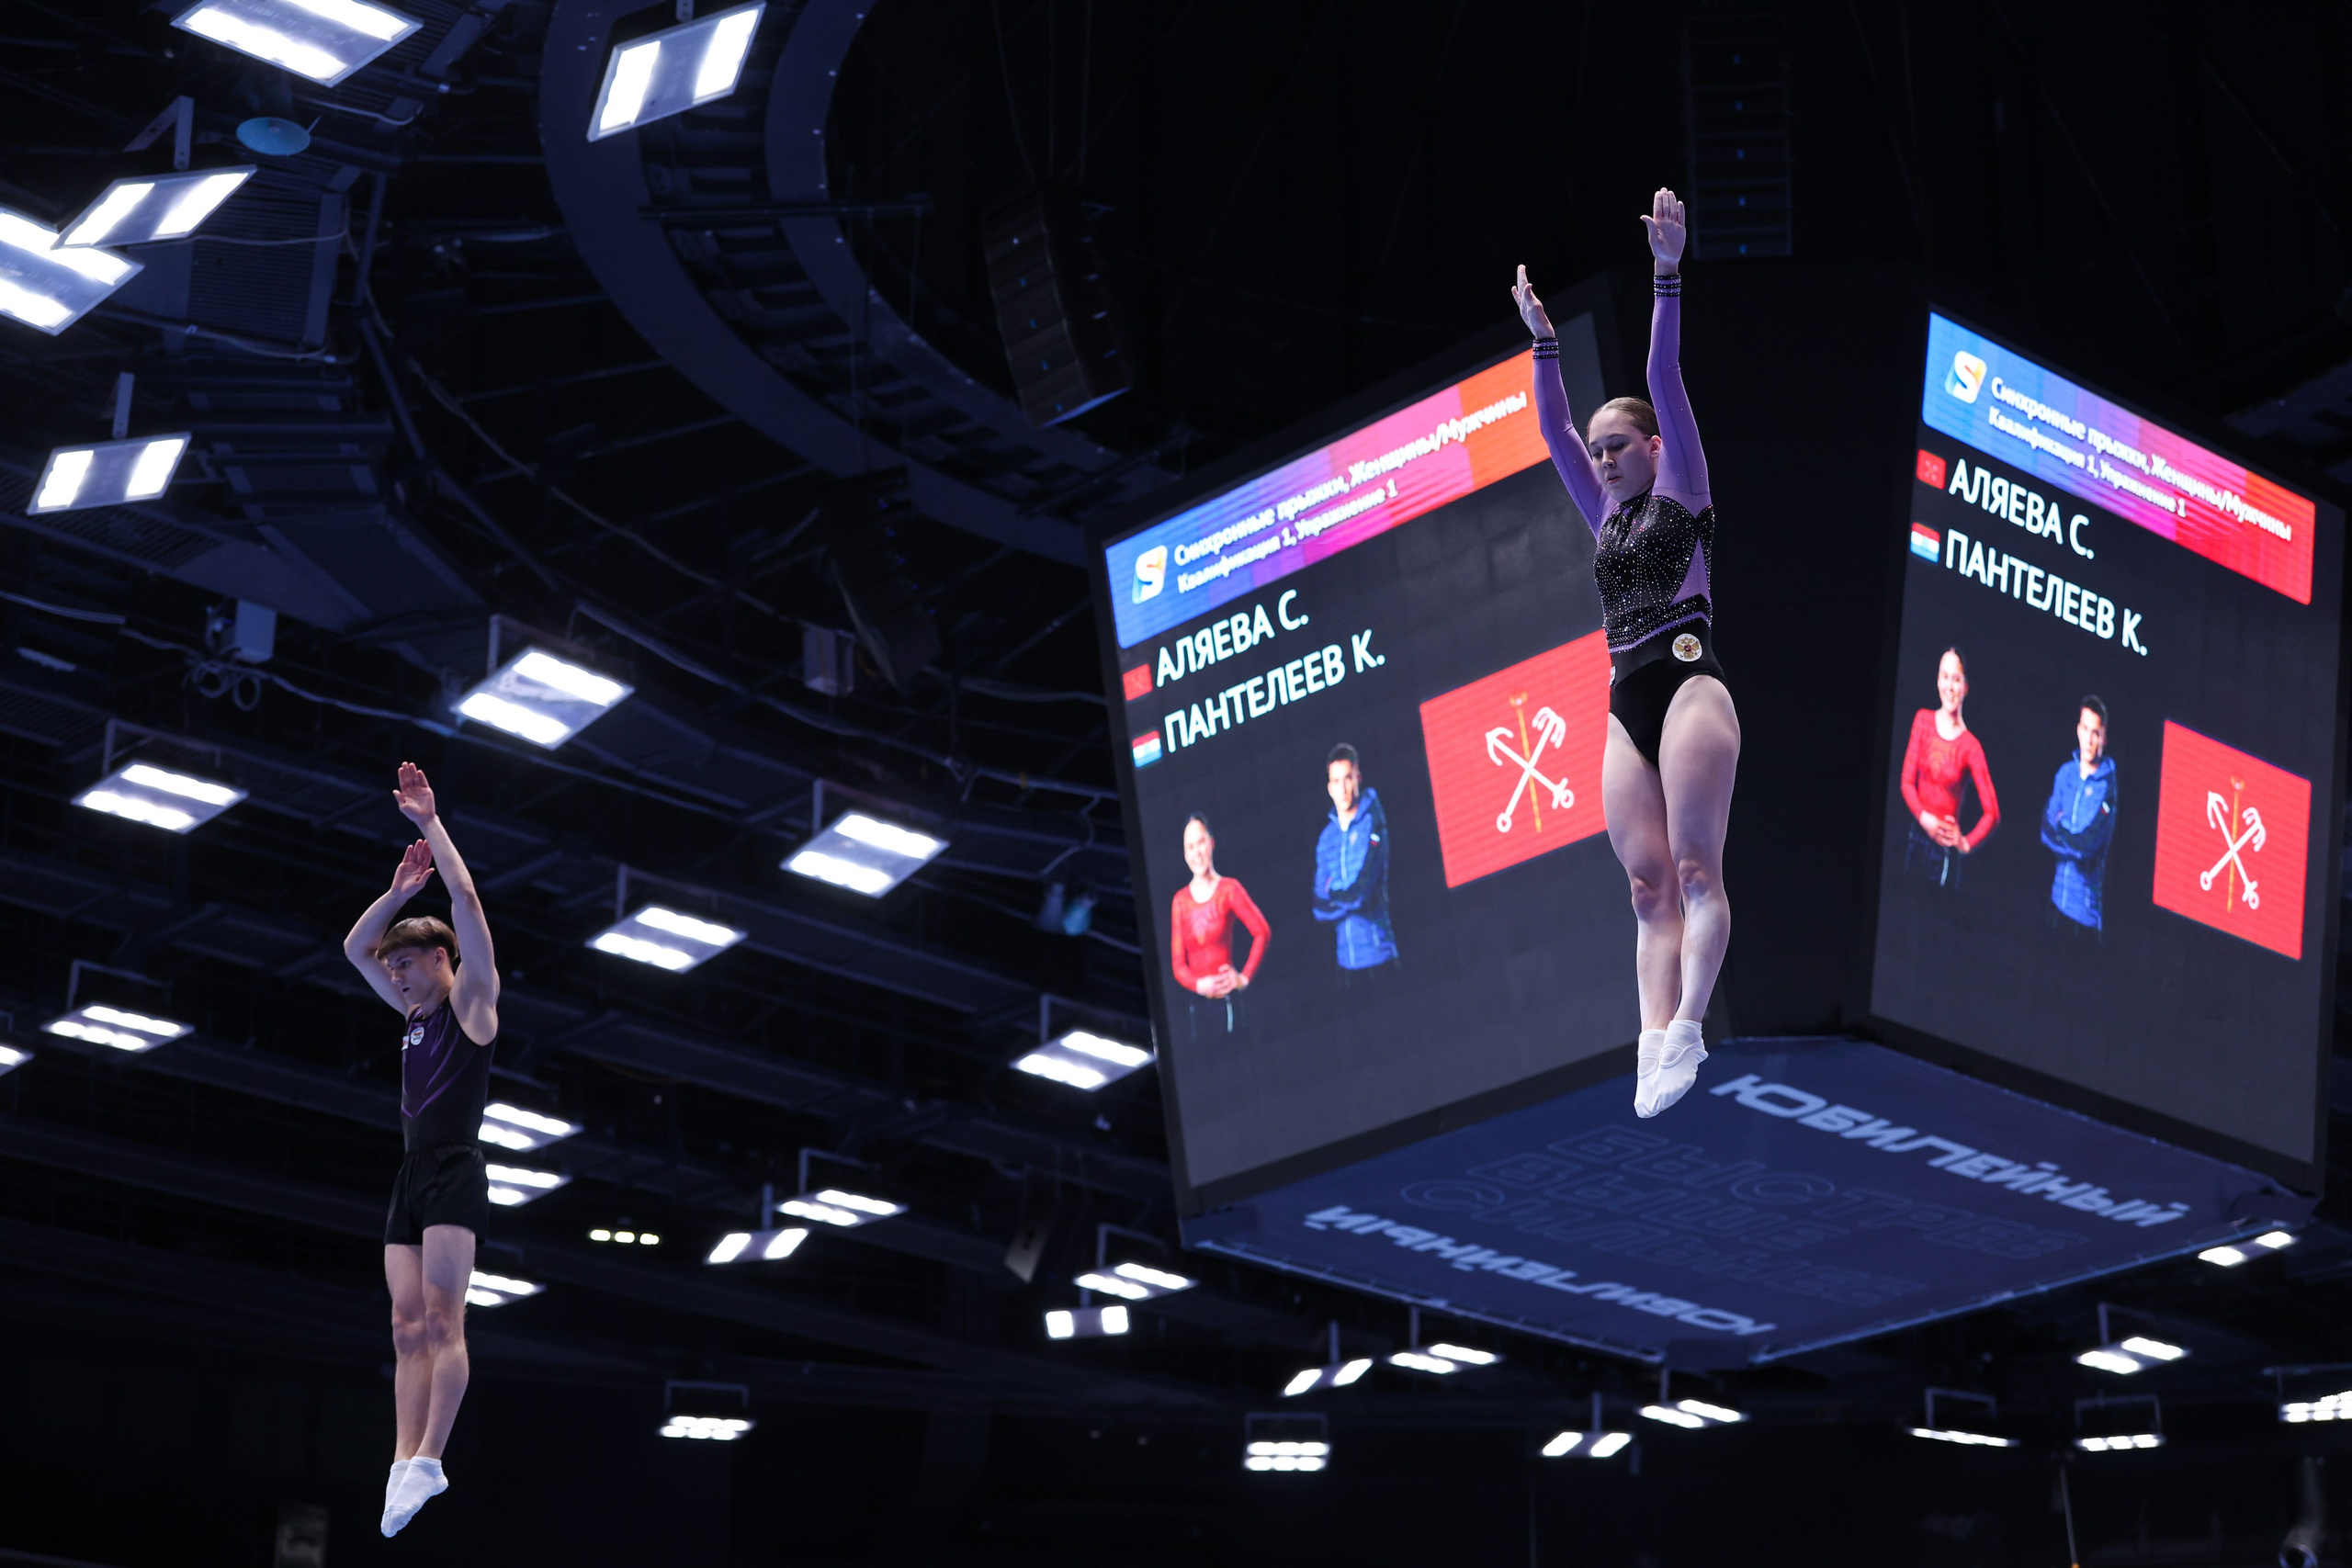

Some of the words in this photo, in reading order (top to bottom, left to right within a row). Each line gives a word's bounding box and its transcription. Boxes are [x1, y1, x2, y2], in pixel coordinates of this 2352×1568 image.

[1174, 508, 1275, 566] Синхронные
[1277, 476, 1350, 521] прыжки,
[1348, 391, 1527, 488] Женщины/Мужчины
[1948, 458, 2064, 546] АЛЯЕВА
[2069, 513, 2095, 560] С.
[1988, 405, 2086, 469] Квалификация
[2099, 458, 2177, 513] Упражнение
[2177, 498, 2187, 518] 1
[1991, 377, 2086, 441] Синхронные
[2087, 428, 2151, 475] прыжки,
[2151, 454, 2291, 541] Женщины/Мужчины
[1177, 536, 1281, 593] Квалификация
[1295, 488, 1385, 539] Упражнение
[1386, 479, 1398, 499] 1
[1945, 528, 2114, 639] ПАНТЕЛЕЕВ
[2122, 608, 2148, 657] К.
[1156, 604, 1275, 688] АЛЯЕВА
[1277, 589, 1309, 632] С.
[1163, 643, 1346, 753] ПАНТЕЛЕЕВ
[1352, 629, 1386, 674] К.
[1547, 1122, 2092, 1261] БЫСТРЕЕ
[1709, 1074, 2191, 1227] ЮБИЛЕЙНЫЙ
[1304, 1205, 1777, 1336] ЮБИЛЕЙНЫЙ
